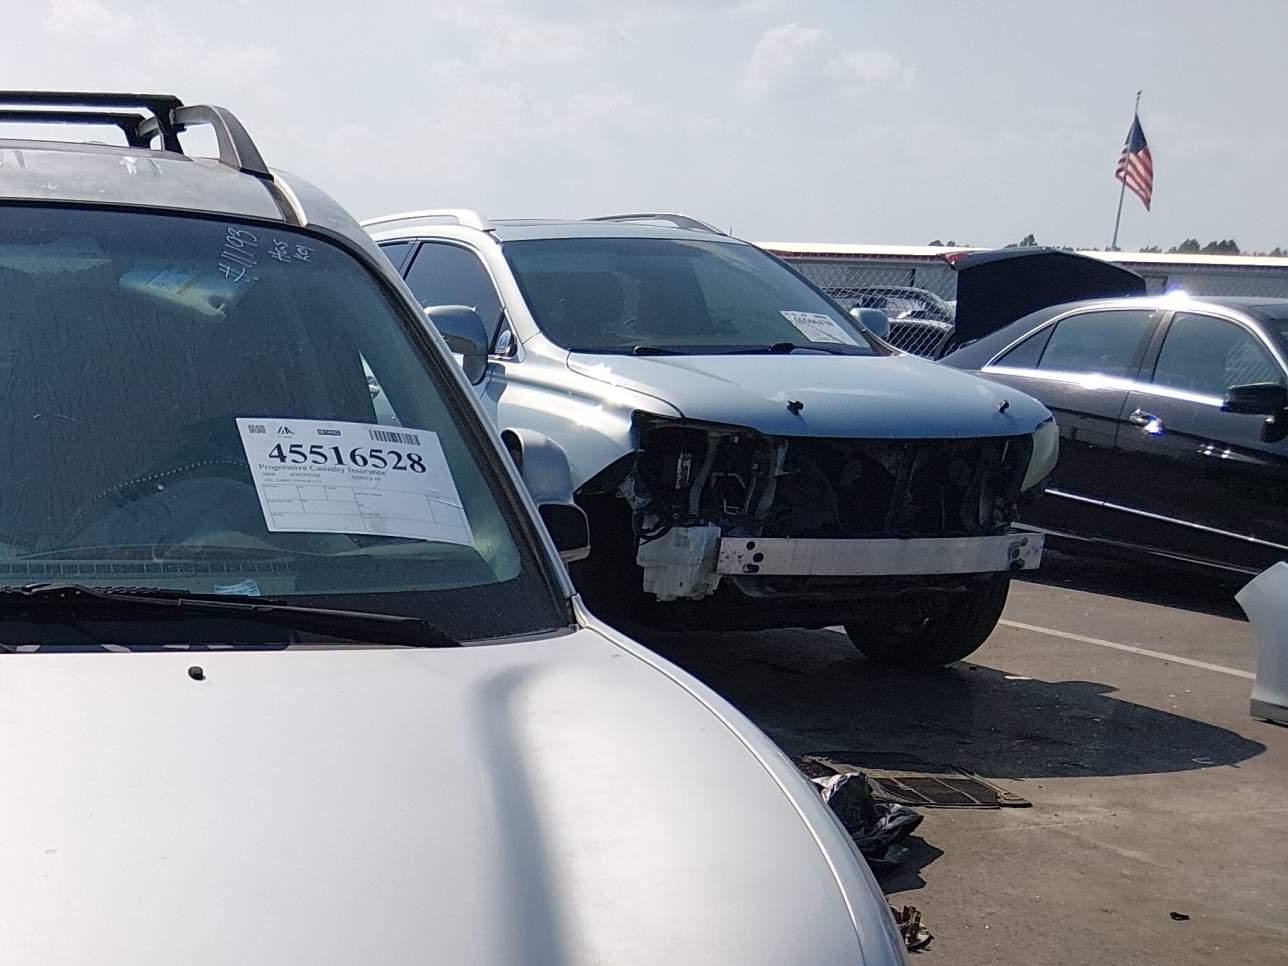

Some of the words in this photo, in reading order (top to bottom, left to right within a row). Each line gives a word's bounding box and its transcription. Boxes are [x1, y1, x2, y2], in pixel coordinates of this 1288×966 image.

[268, 442, 428, 474] 45516528
[259, 463, 308, 472] Progressive
[309, 464, 345, 474] Casualty
[347, 466, 387, 476] Insurance
